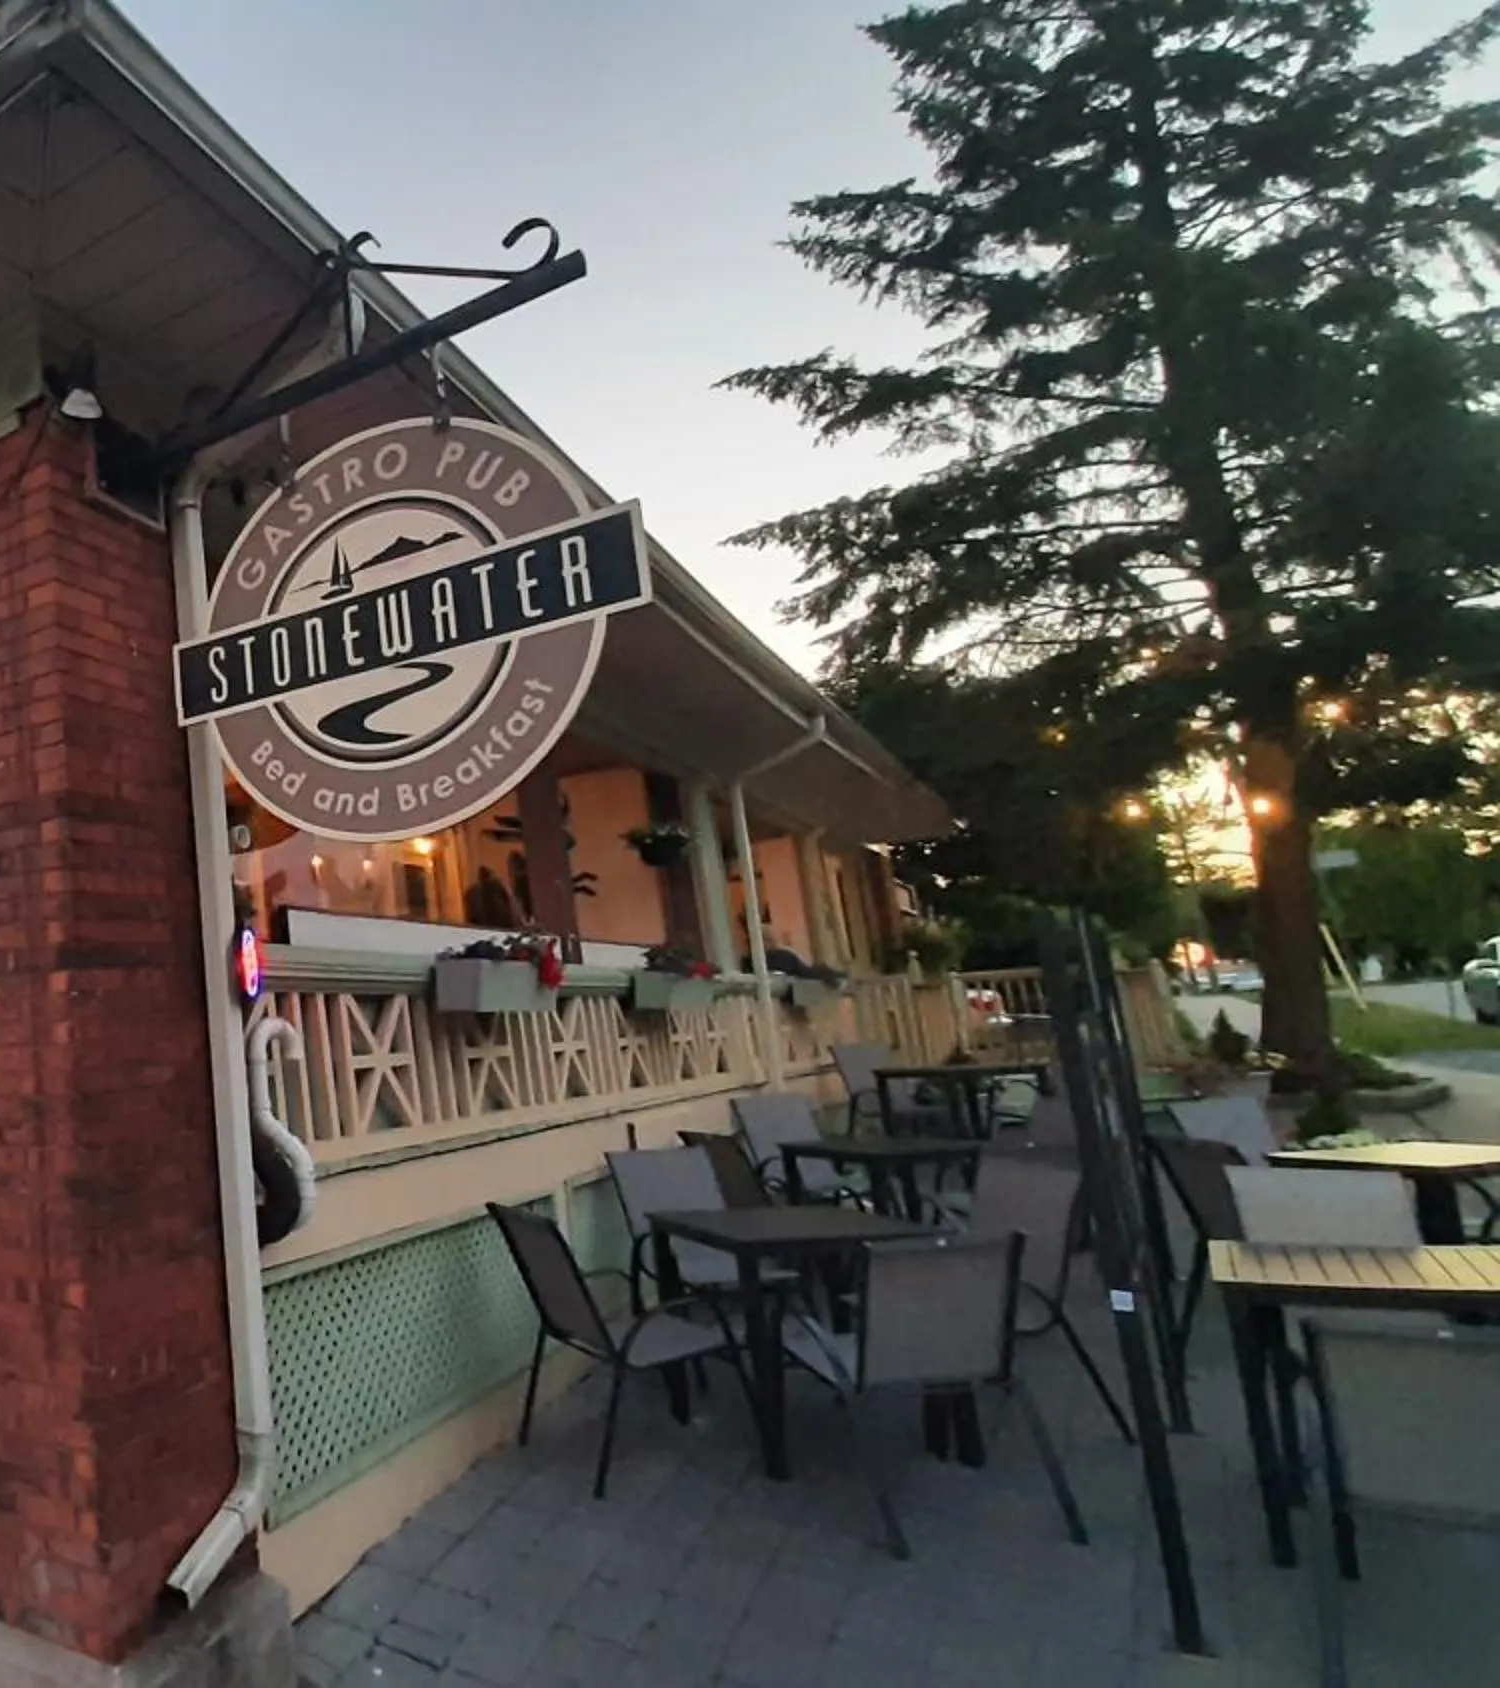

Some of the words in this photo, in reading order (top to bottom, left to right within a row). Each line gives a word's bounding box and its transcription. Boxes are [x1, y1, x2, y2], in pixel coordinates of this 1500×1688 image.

[236, 442, 408, 591] GASTRO
[435, 440, 531, 508] PUB
[208, 535, 593, 703] STONEWATER
[251, 739, 307, 798] Bed
[313, 786, 380, 818] and
[396, 676, 555, 814] Breakfast
